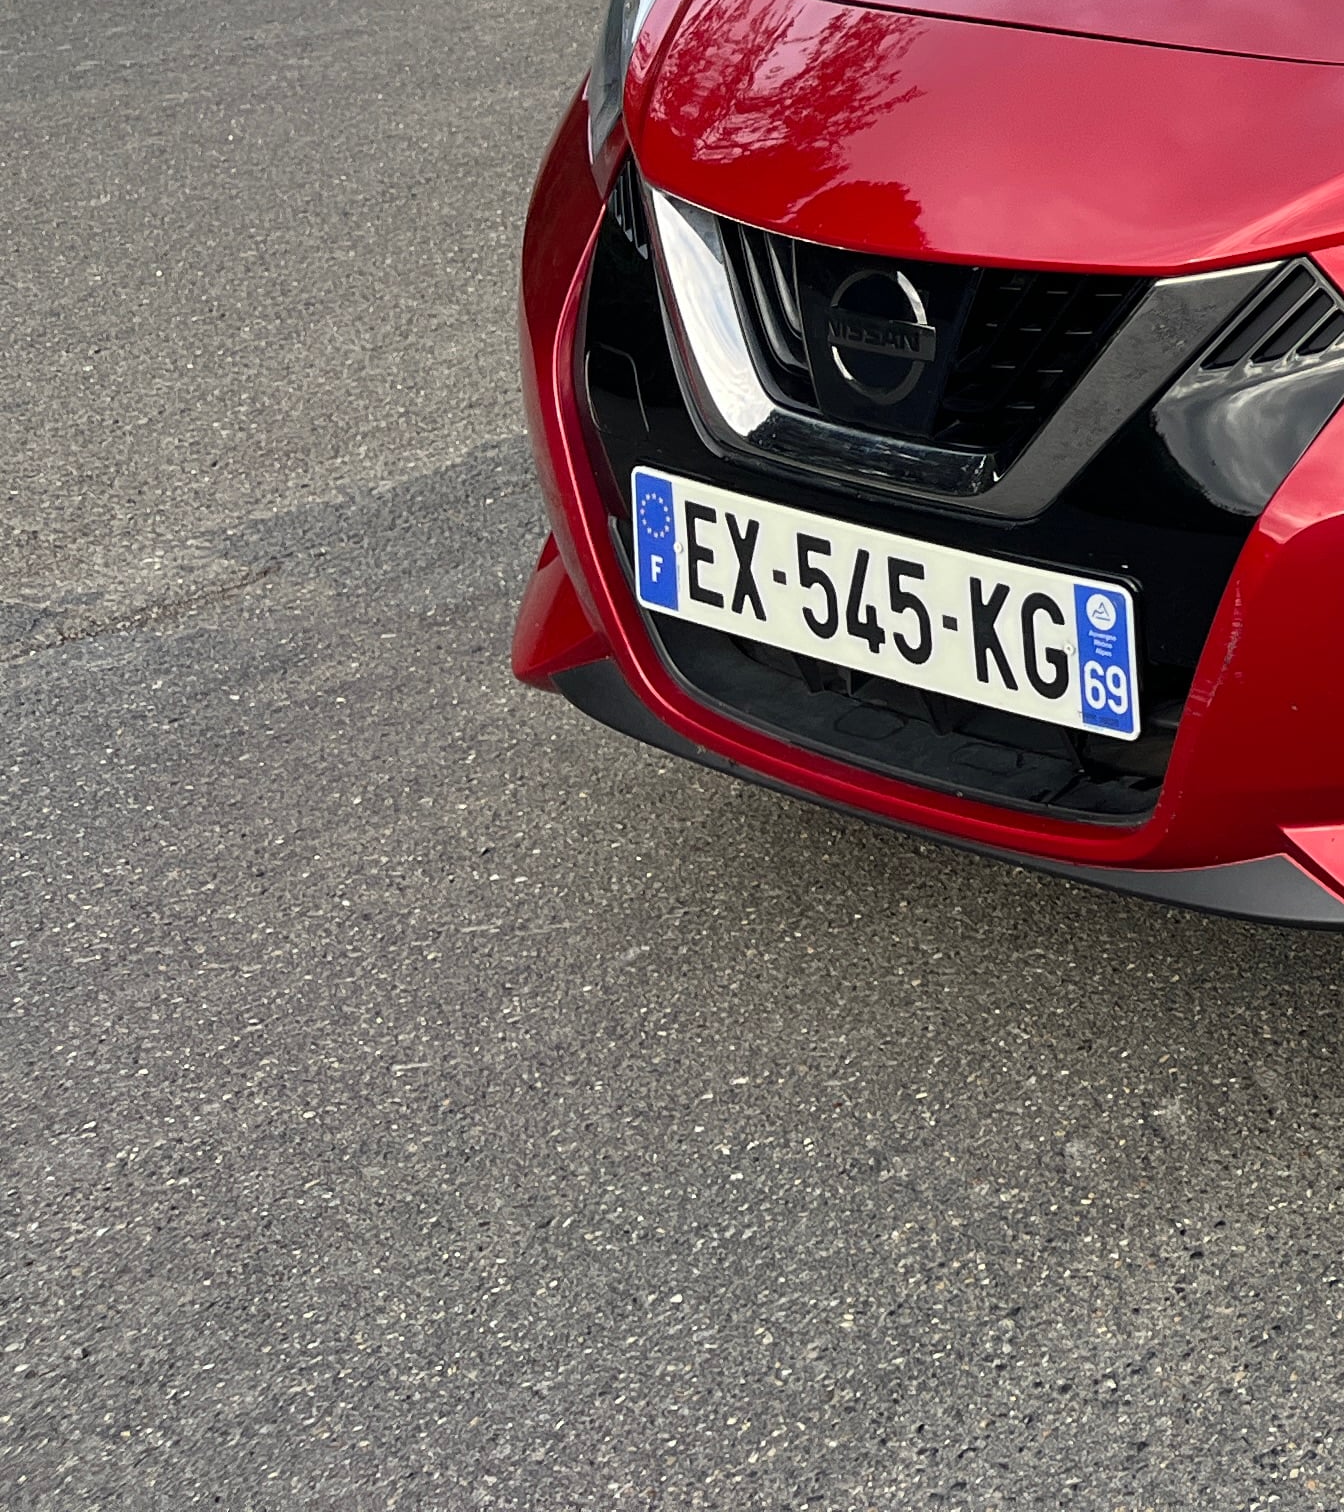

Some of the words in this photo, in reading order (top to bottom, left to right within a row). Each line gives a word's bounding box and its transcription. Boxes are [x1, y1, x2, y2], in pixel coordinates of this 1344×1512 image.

[828, 318, 920, 353] NISSAN
[651, 555, 663, 583] F
[684, 500, 1070, 699] EX-545-KG
[1084, 660, 1129, 715] 69
